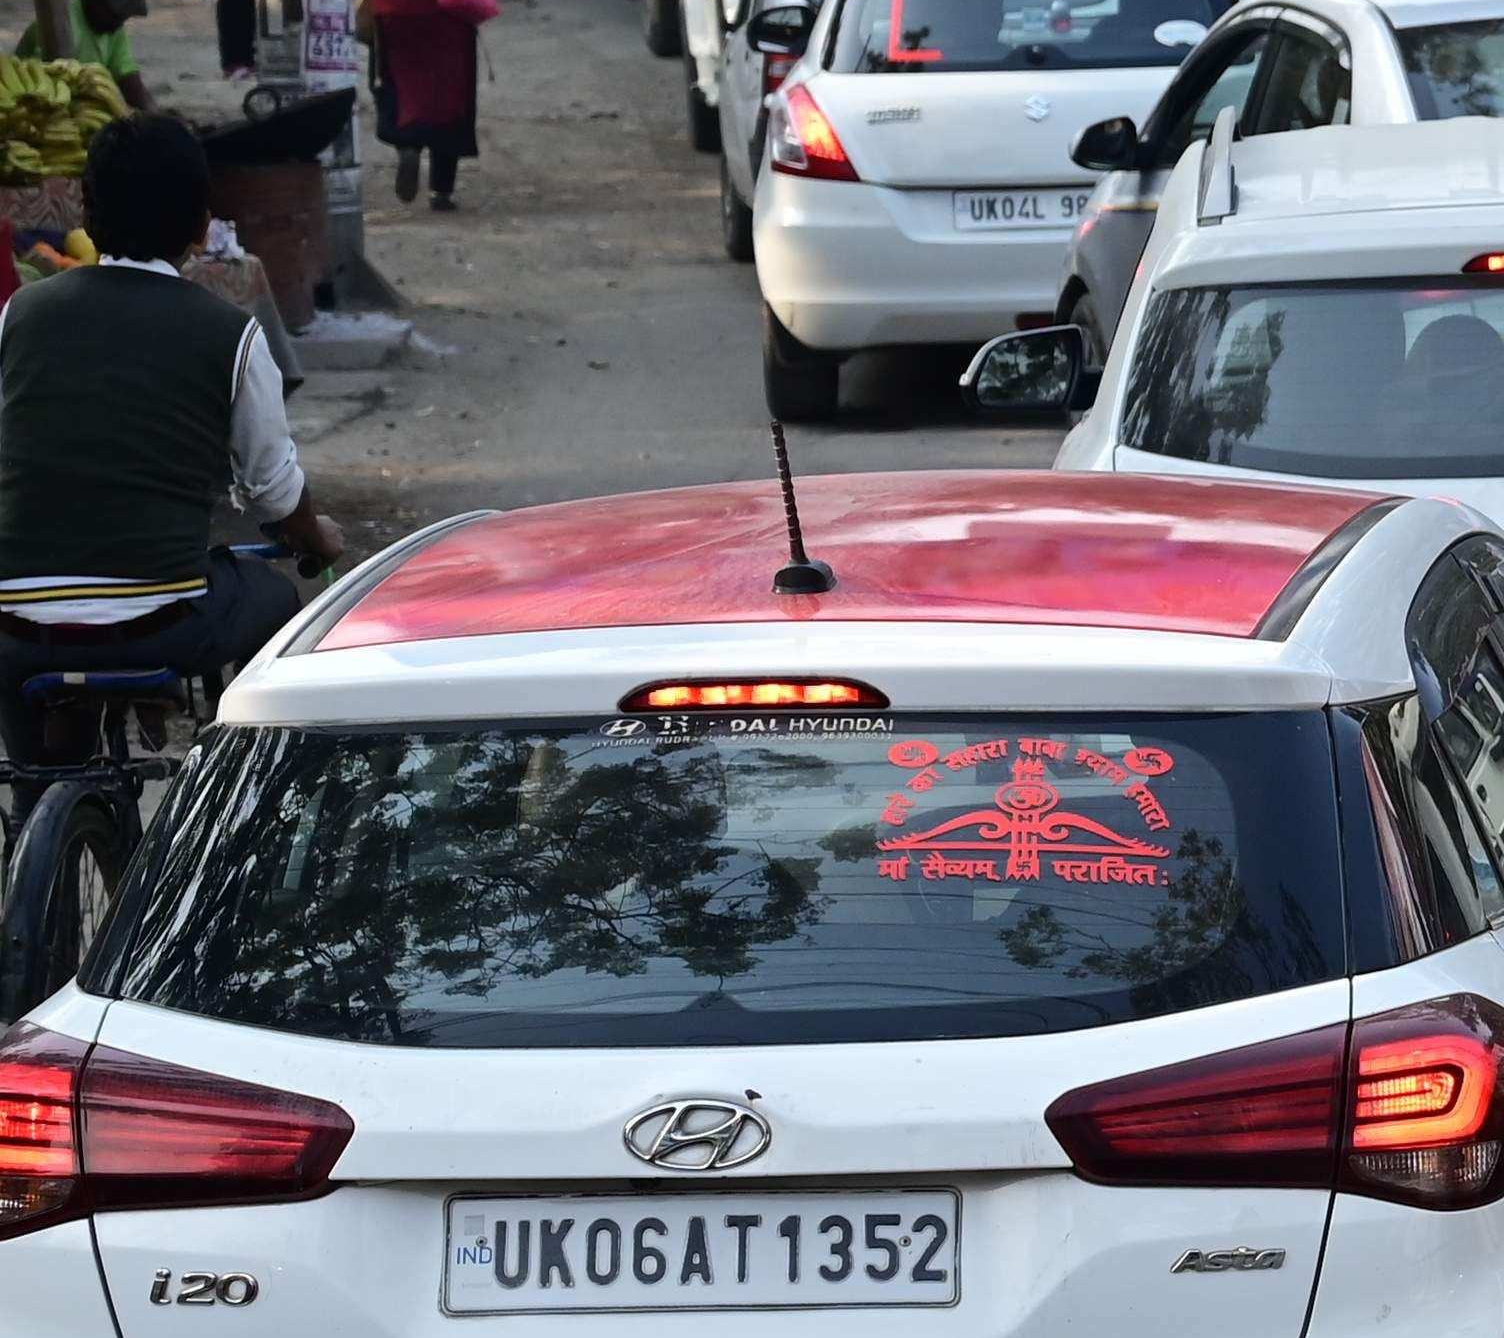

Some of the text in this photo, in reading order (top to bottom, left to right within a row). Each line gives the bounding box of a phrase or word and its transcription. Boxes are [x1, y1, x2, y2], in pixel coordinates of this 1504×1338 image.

[969, 193, 1045, 222] UK04L
[788, 717, 894, 732] HYUNDAI
[591, 736, 650, 749] HYUNDAI
[941, 739, 1010, 771] सहारा
[1018, 737, 1068, 759] बाबा
[1124, 780, 1171, 832] हमारा
[456, 1212, 949, 1289] IND UK06AT1352
[1169, 1246, 1286, 1274] Asta
[150, 1266, 259, 1307] i20
